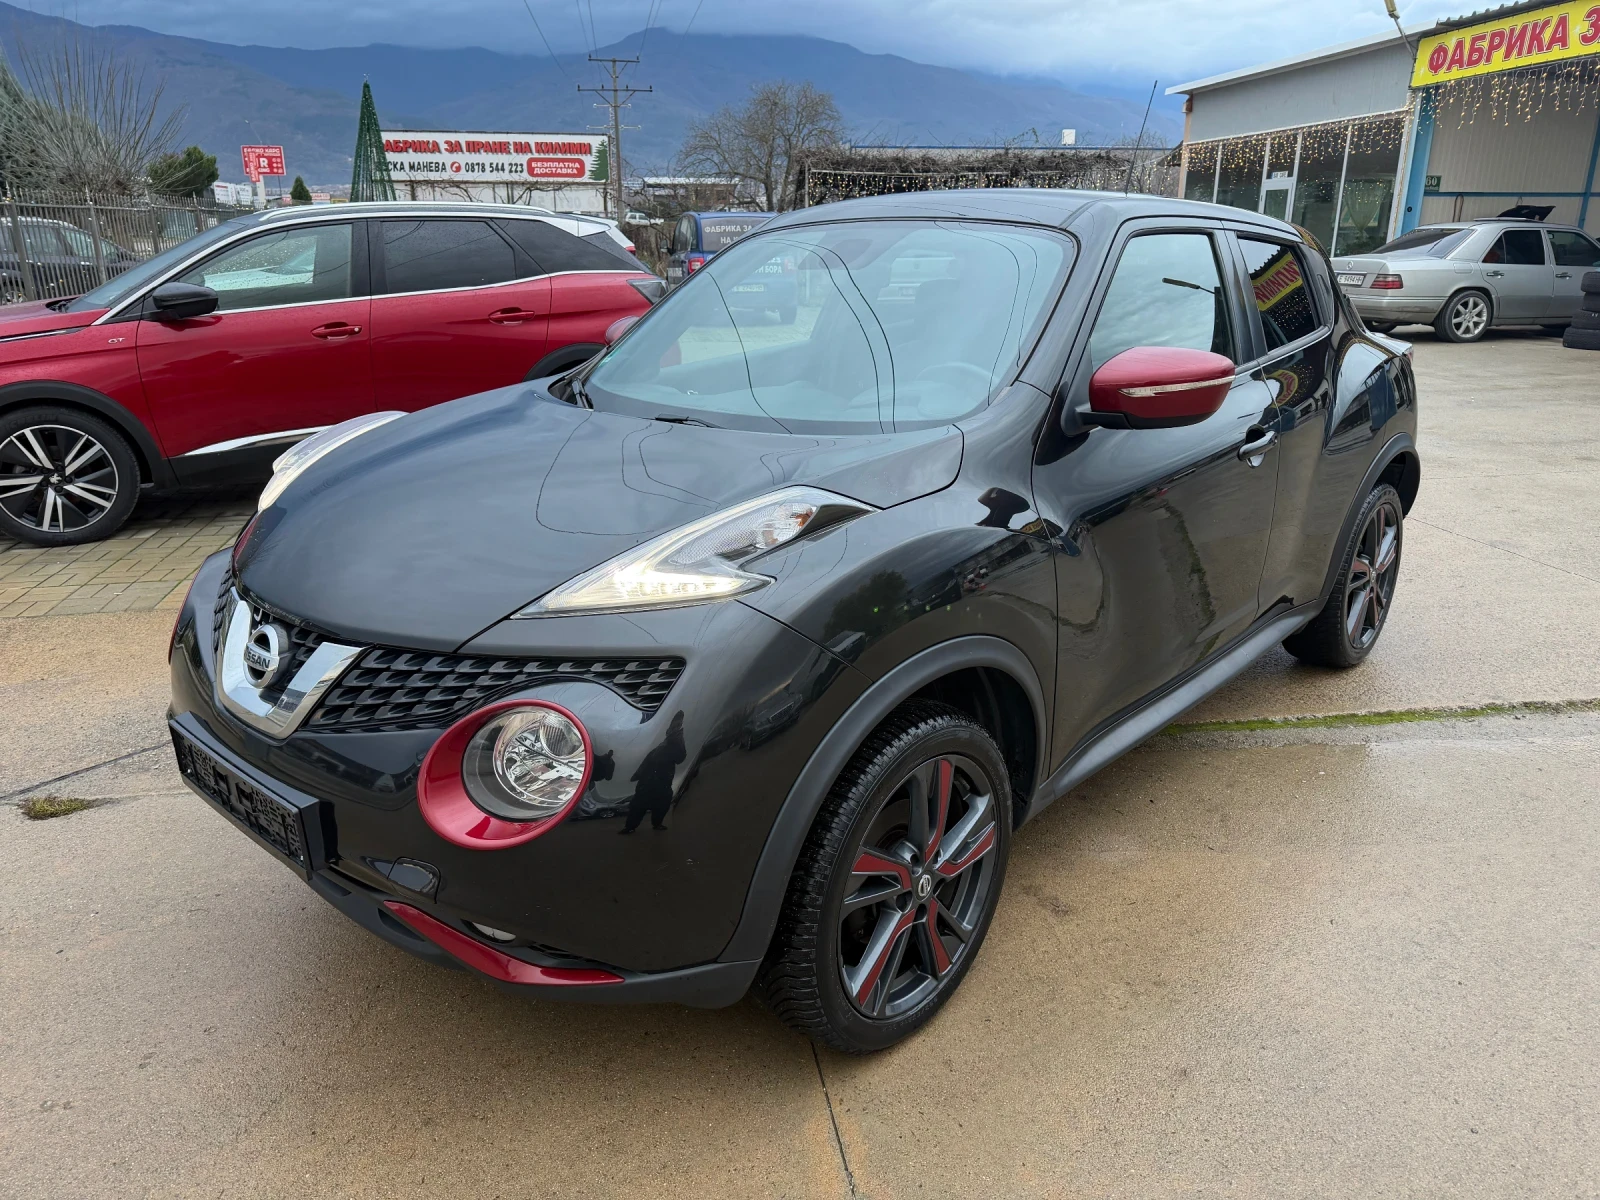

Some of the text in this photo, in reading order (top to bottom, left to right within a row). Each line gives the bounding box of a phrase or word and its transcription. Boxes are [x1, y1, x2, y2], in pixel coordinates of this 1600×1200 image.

[1428, 5, 1600, 76] ФАБРИКА З
[383, 139, 592, 155] АБРИКА ЗА ПРАНЕ НА КИЛИМИ
[388, 161, 524, 173] СКА МАНЕВА 0878 544 223
[704, 225, 741, 233] ФАБРИКА
[765, 265, 783, 273] БОРА
[244, 648, 270, 668] ISSAN
